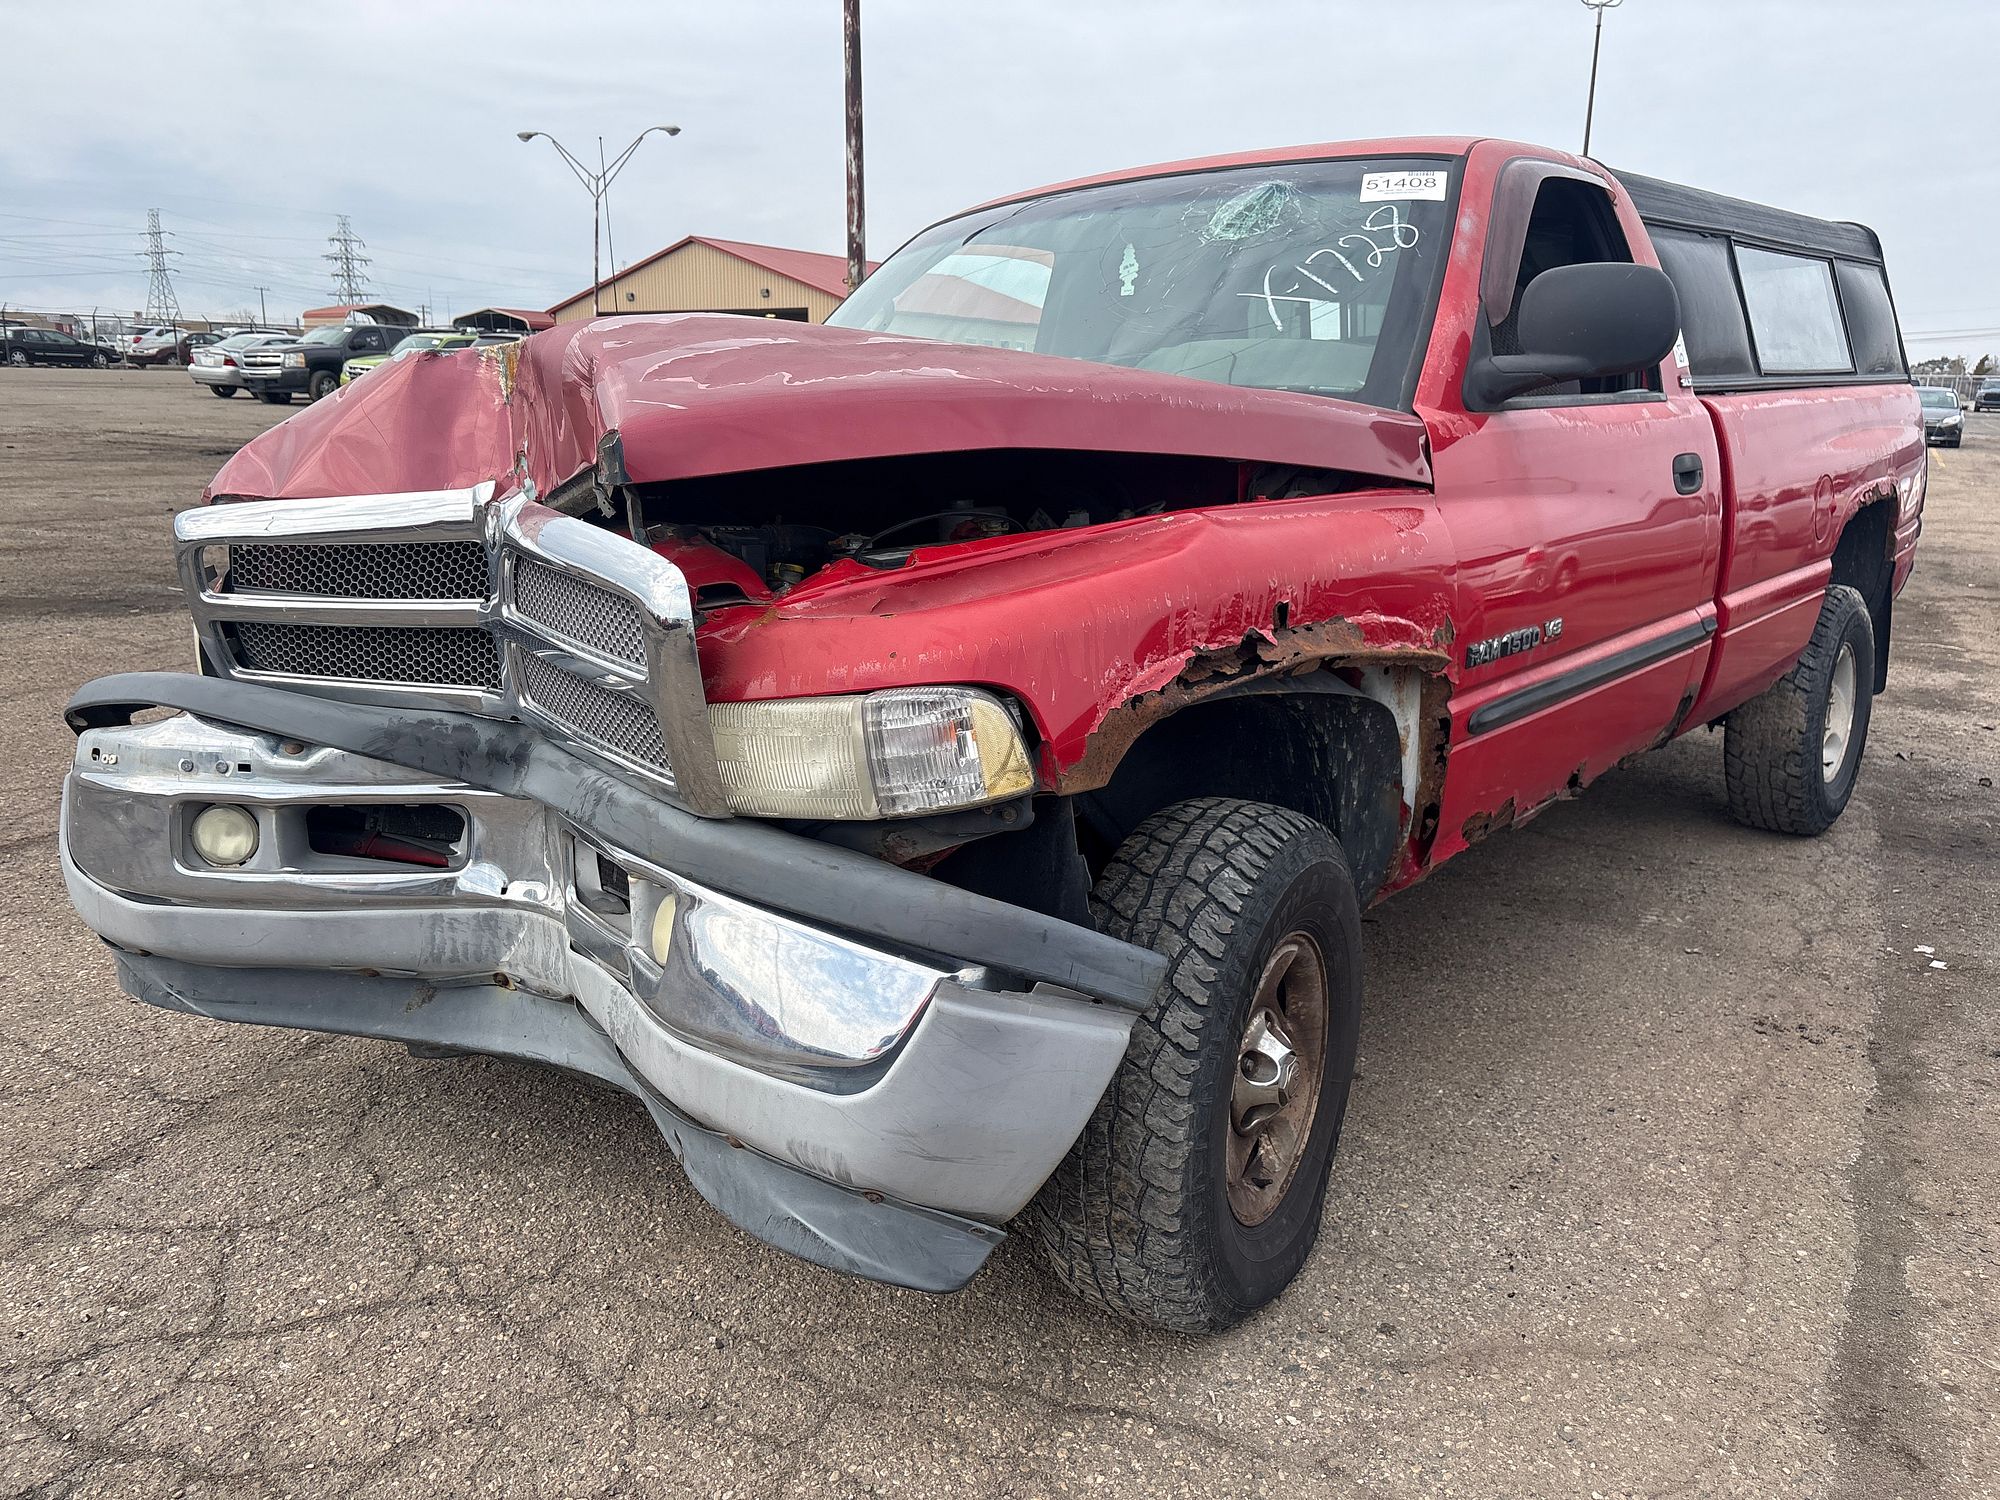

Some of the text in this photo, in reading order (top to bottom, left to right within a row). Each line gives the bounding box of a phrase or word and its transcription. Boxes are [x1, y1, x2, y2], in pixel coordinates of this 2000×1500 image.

[1365, 177, 1437, 190] 51408
[1465, 638, 1500, 669] RAM
[1501, 625, 1540, 656] 1500
